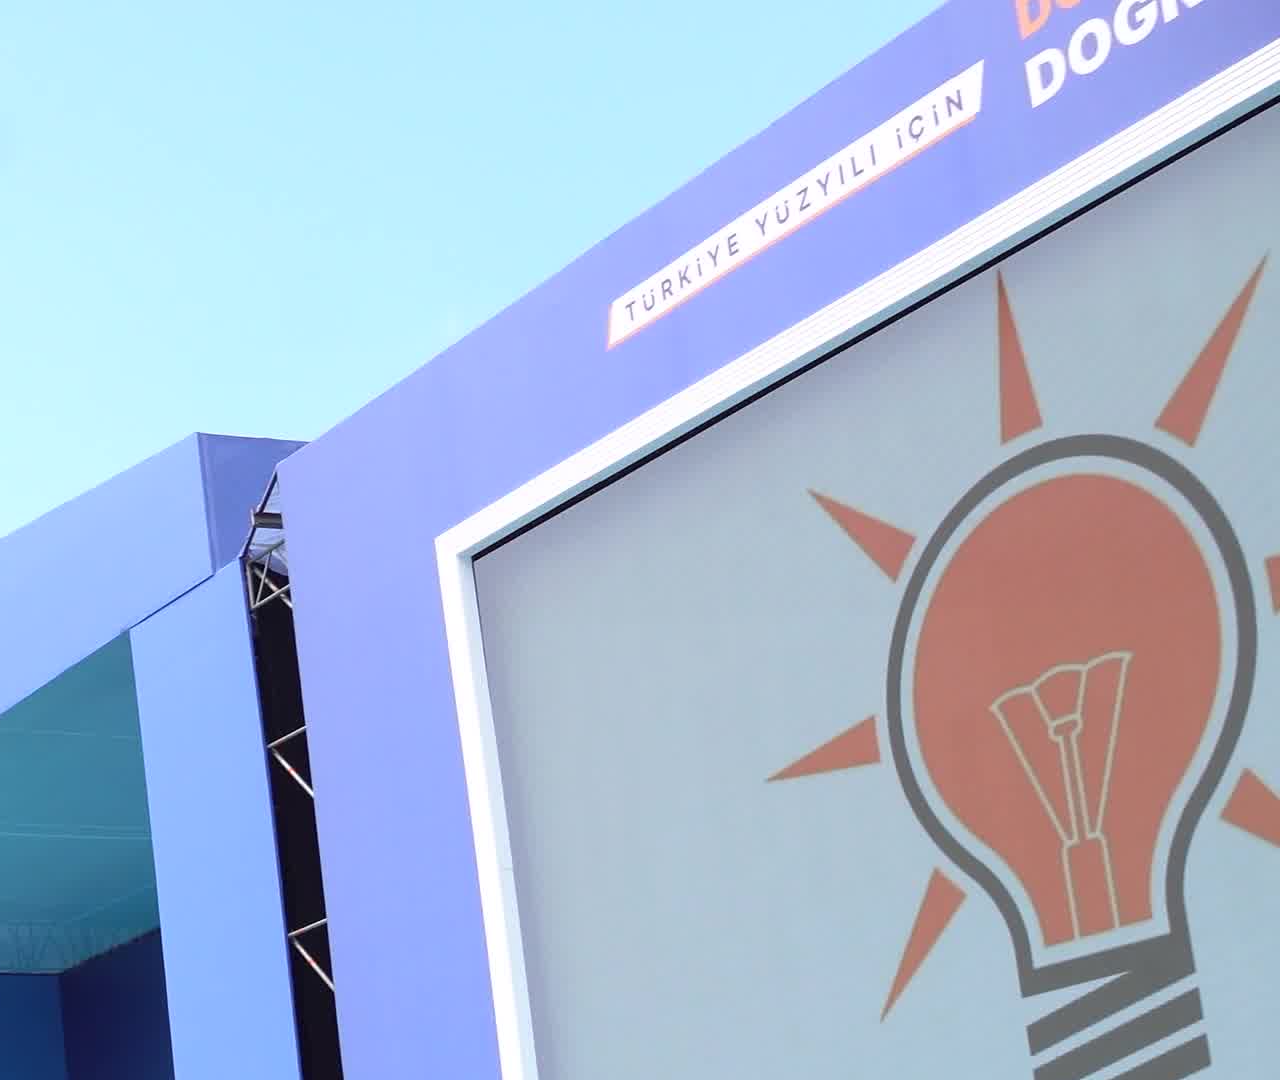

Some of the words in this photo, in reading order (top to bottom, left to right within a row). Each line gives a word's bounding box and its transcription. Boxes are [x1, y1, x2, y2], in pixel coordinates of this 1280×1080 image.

[625, 231, 739, 321] TÜRKİYE
[754, 143, 877, 237] YÜZYILI
[895, 89, 964, 150] İÇİN
